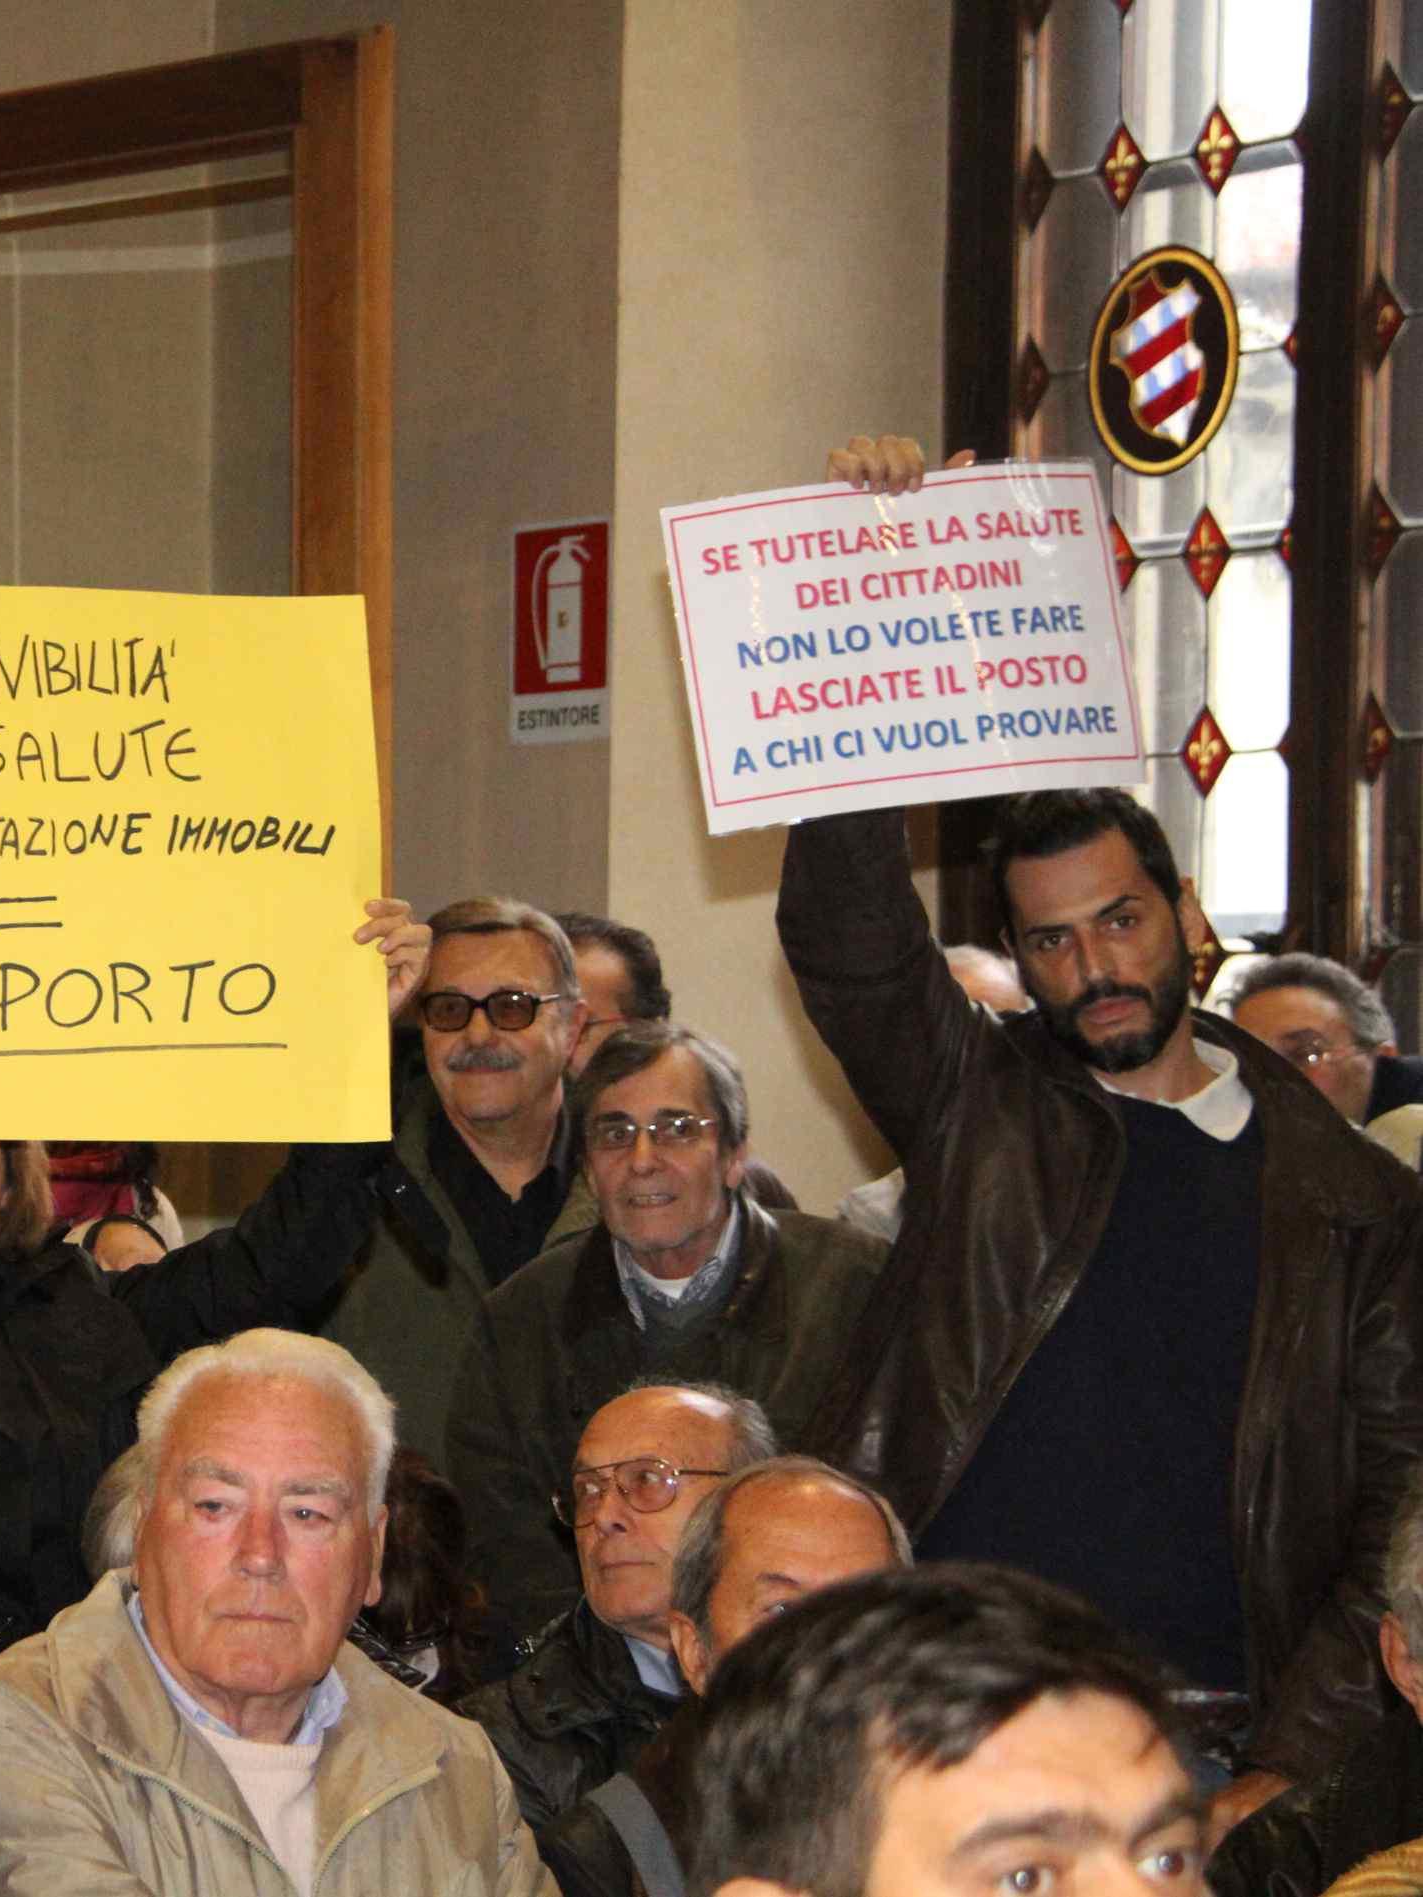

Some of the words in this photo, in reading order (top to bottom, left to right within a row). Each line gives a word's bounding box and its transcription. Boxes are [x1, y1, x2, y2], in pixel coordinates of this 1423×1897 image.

[702, 544, 741, 576] SE
[748, 522, 916, 567] TUTELARE
[926, 515, 967, 545] LA
[975, 508, 1084, 540] SALUTE
[795, 577, 850, 609] DEI
[860, 560, 1022, 602] CITTADINI
[737, 632, 817, 668] NON
[828, 624, 871, 656] LO
[880, 609, 1001, 648] VOLETE
[1011, 604, 1085, 635] FARE
[517, 704, 600, 730] ESTINTORE
[752, 668, 923, 721] LASCIATE
[935, 665, 967, 695] IL
[976, 654, 1088, 689] POSTO
[732, 747, 758, 775] A
[766, 735, 823, 769] CHI
[833, 729, 864, 759] CI
[875, 719, 967, 753] VUOL
[977, 705, 1118, 742] PROVARE
[166, 813, 337, 857] IMMOBILI
